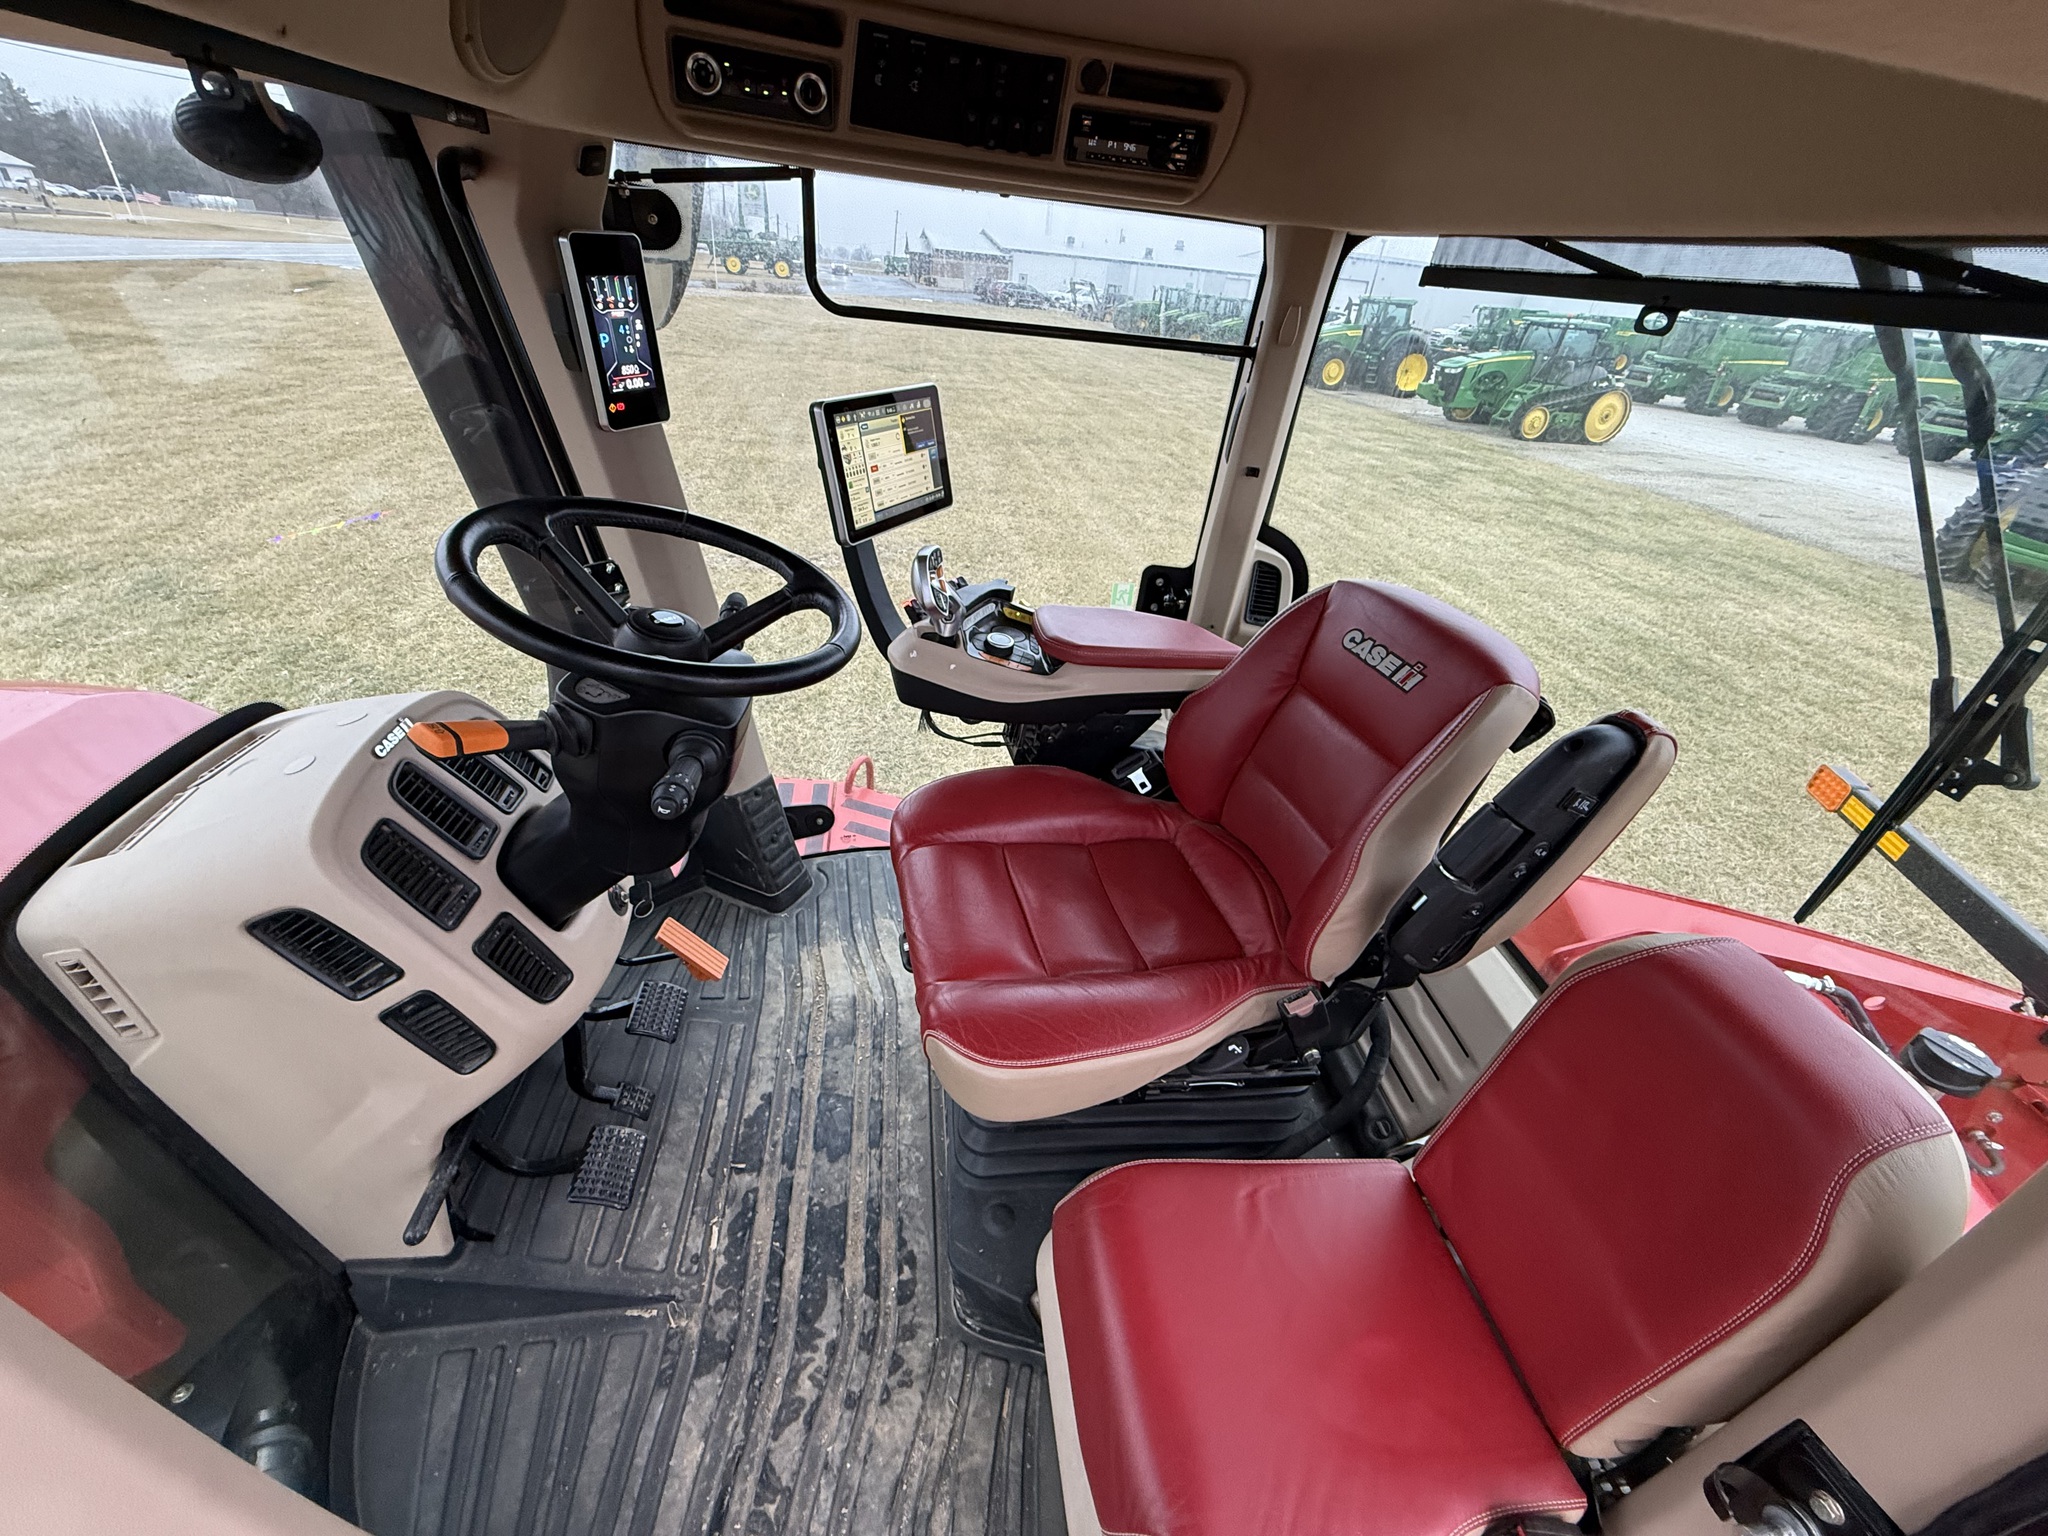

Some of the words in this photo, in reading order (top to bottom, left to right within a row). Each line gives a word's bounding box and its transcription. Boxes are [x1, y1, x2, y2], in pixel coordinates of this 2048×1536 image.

[599, 332, 610, 349] P
[1342, 629, 1403, 677] CASE
[374, 725, 406, 758] CASE
